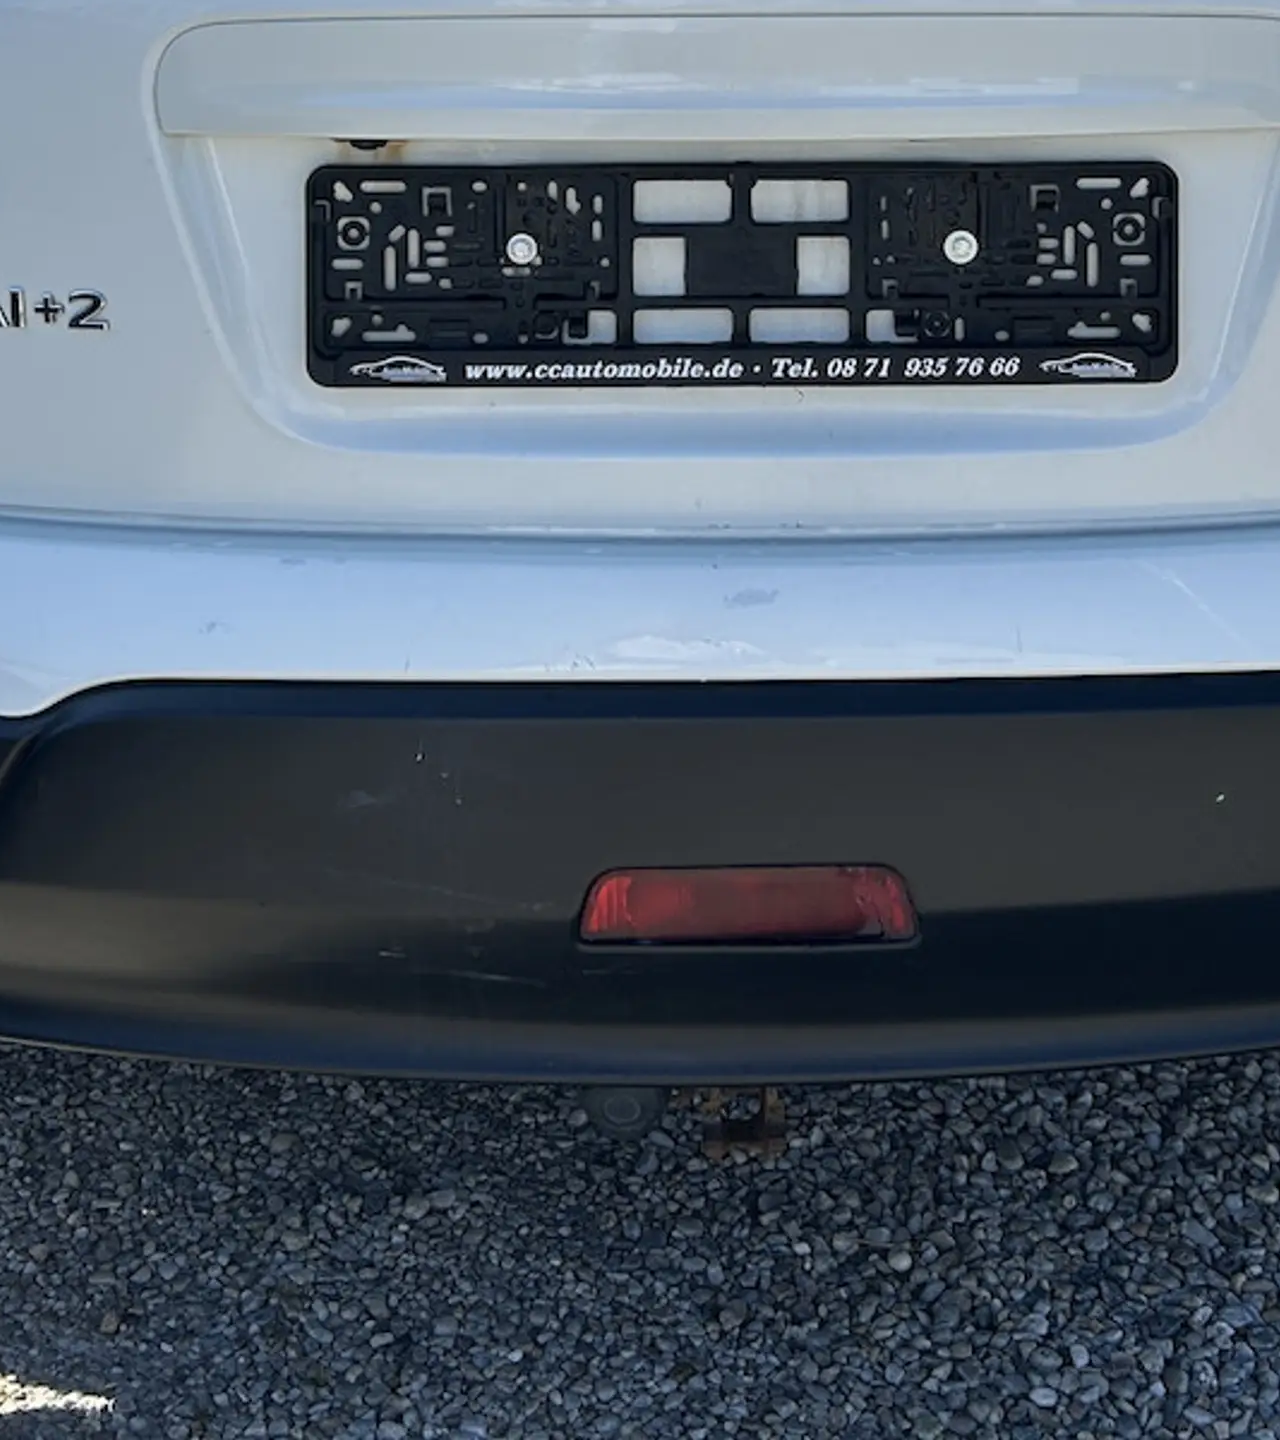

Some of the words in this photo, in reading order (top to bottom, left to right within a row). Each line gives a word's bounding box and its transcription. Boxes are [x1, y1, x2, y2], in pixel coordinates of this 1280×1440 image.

[465, 358, 743, 379] www.ccautomobile.de
[772, 357, 818, 378] Tel.
[827, 357, 856, 378] 08
[863, 357, 891, 378] 71
[904, 357, 949, 377] 935
[955, 357, 984, 377] 76
[989, 357, 1020, 377] 66
